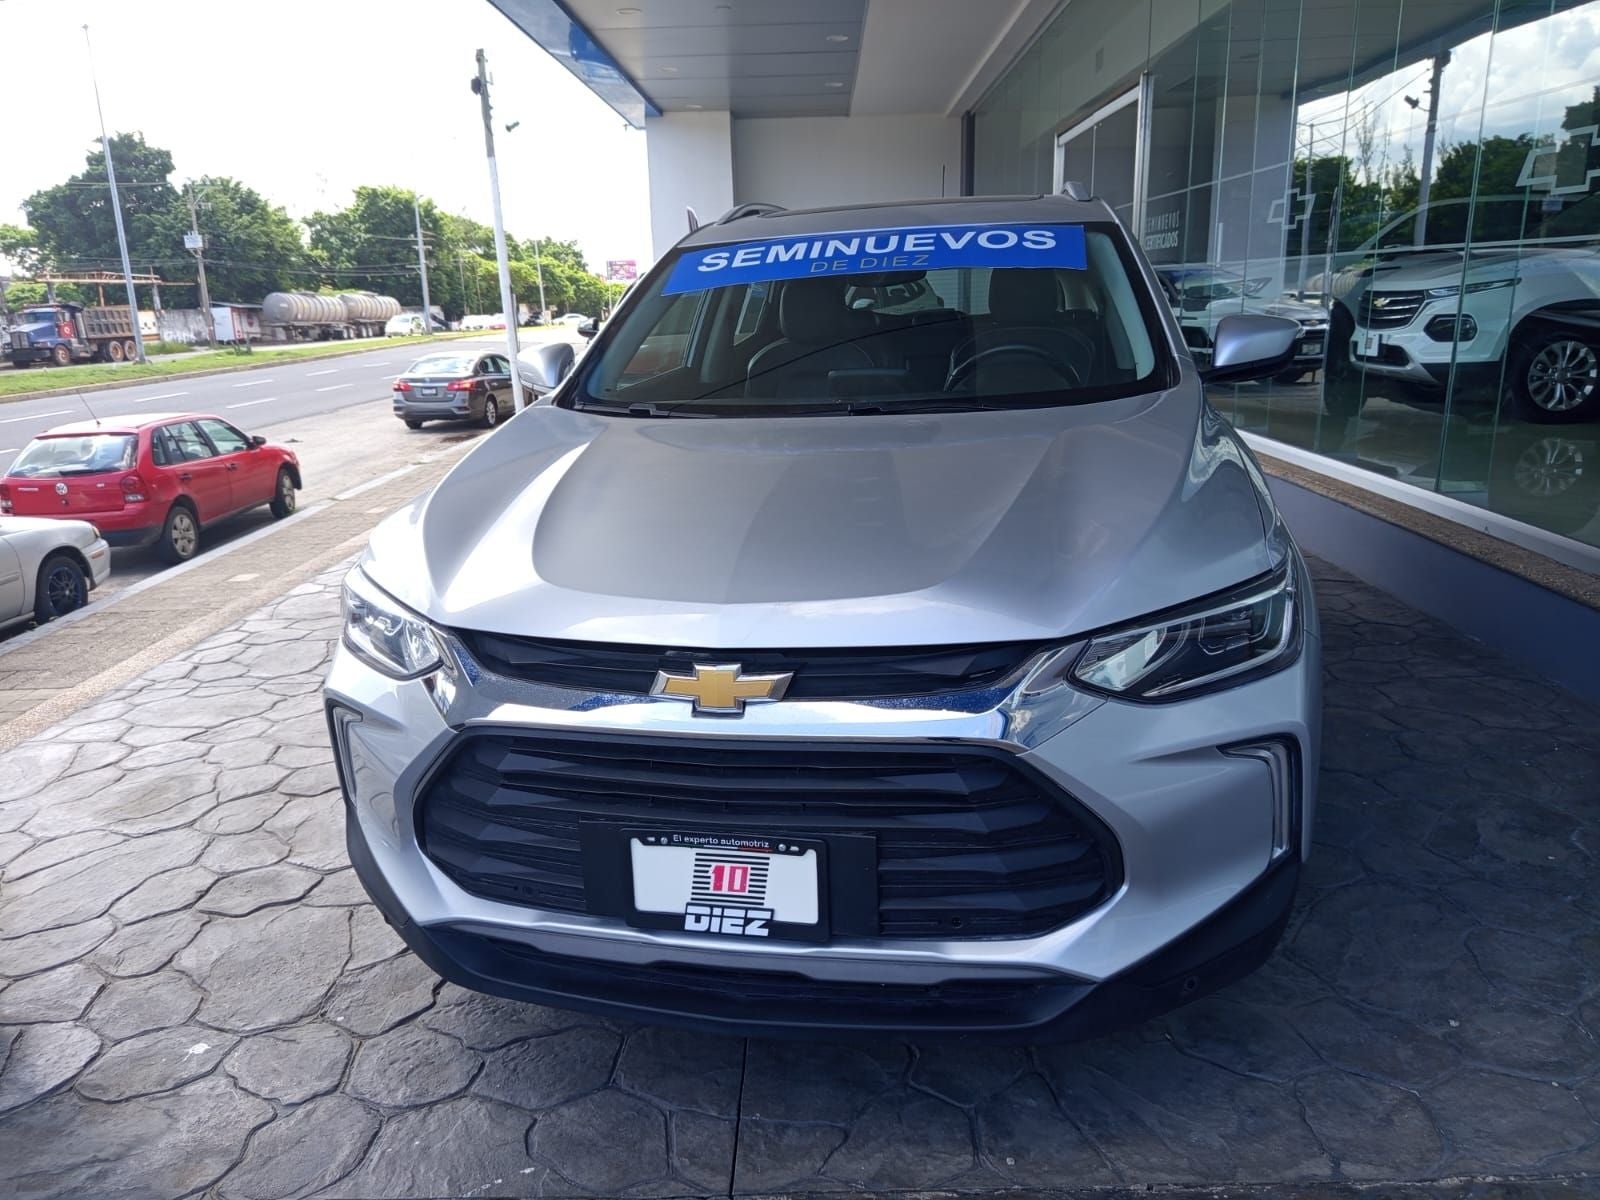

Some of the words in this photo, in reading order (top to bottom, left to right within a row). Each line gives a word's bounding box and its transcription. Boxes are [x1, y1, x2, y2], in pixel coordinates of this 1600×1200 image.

[697, 229, 1057, 273] SEMINUEVOS
[810, 258, 849, 273] DE
[859, 254, 930, 270] DIEZ
[684, 836, 719, 844] experto
[720, 838, 769, 848] automotriz
[712, 865, 749, 893] 10
[684, 905, 772, 937] DIEZ
